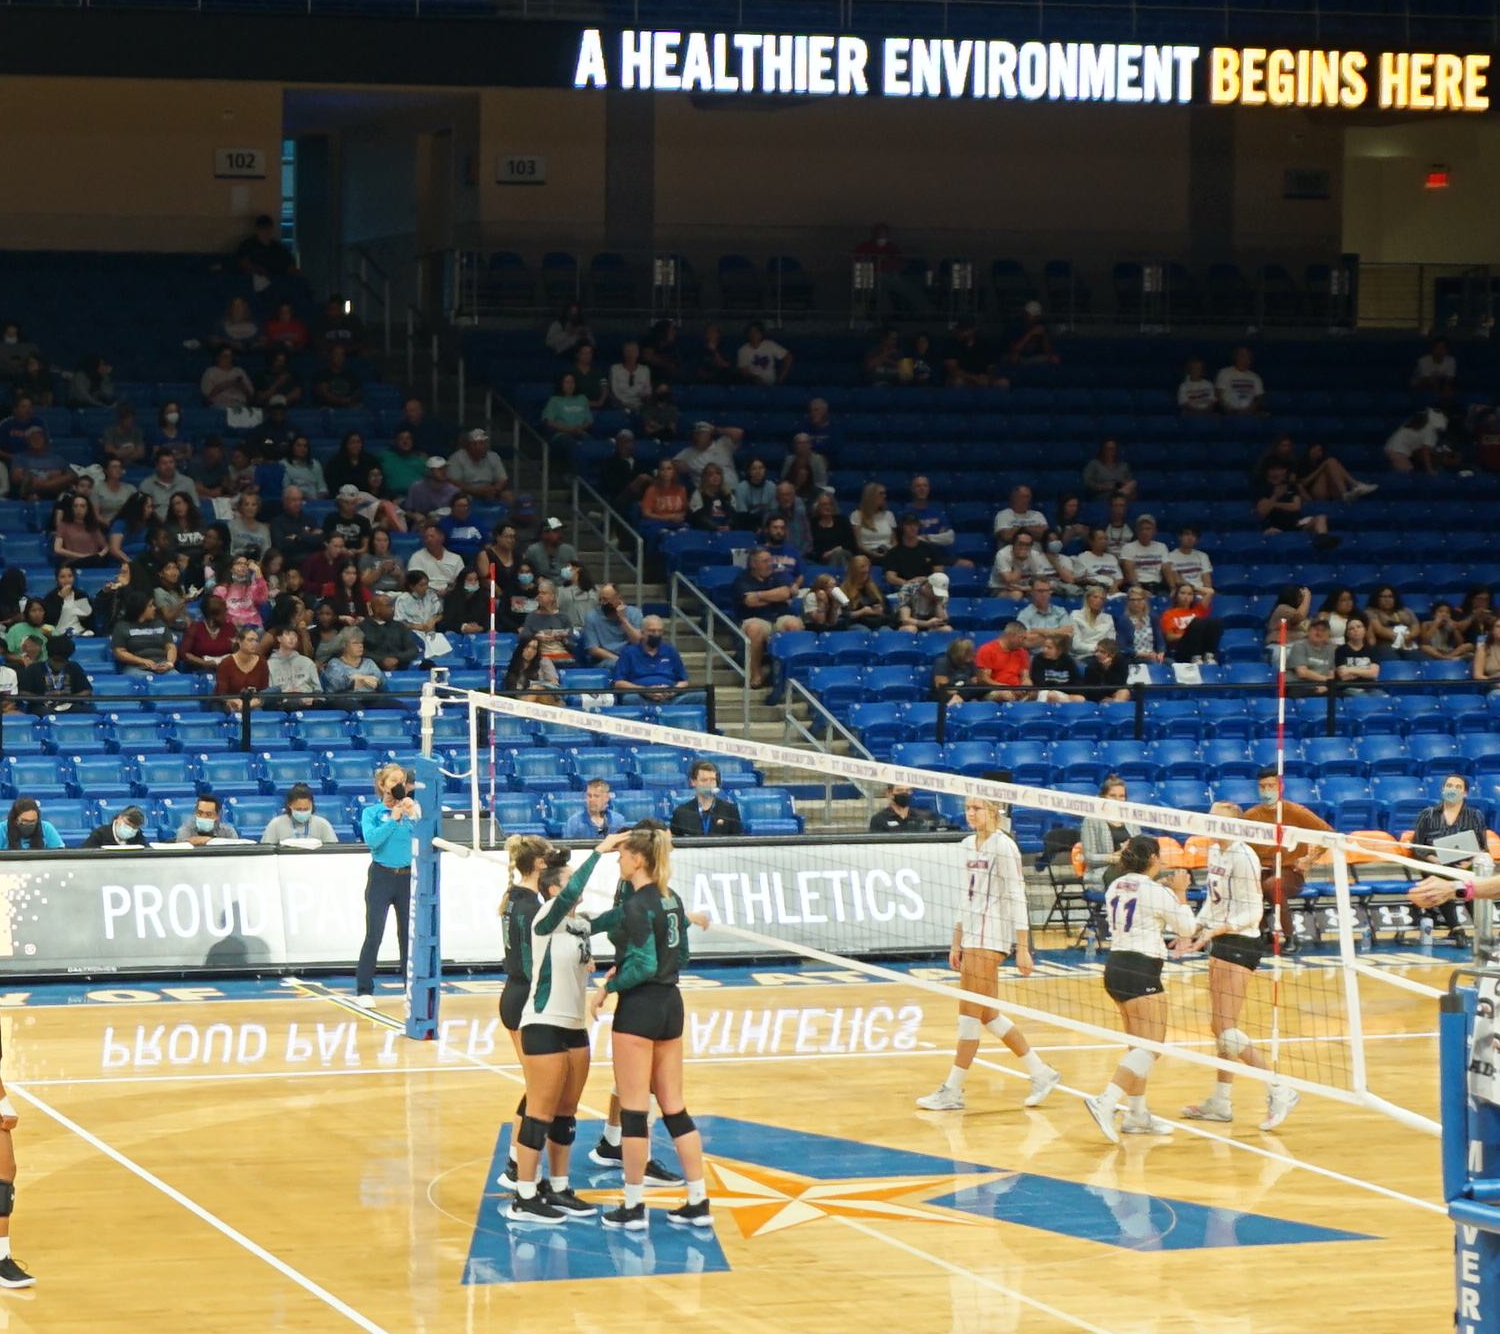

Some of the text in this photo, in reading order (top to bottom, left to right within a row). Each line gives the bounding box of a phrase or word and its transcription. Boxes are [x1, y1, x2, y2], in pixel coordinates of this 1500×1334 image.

[574, 29, 1490, 111] A HEALTHIER ENVIRONMENT BEGINS HERE
[227, 153, 256, 169] 102
[509, 160, 536, 175] 103
[102, 880, 265, 942] PROUD
[692, 867, 926, 927] ATHLETICS
[1111, 894, 1138, 933] 11
[667, 912, 680, 948] 3
[86, 986, 227, 1003] OF
